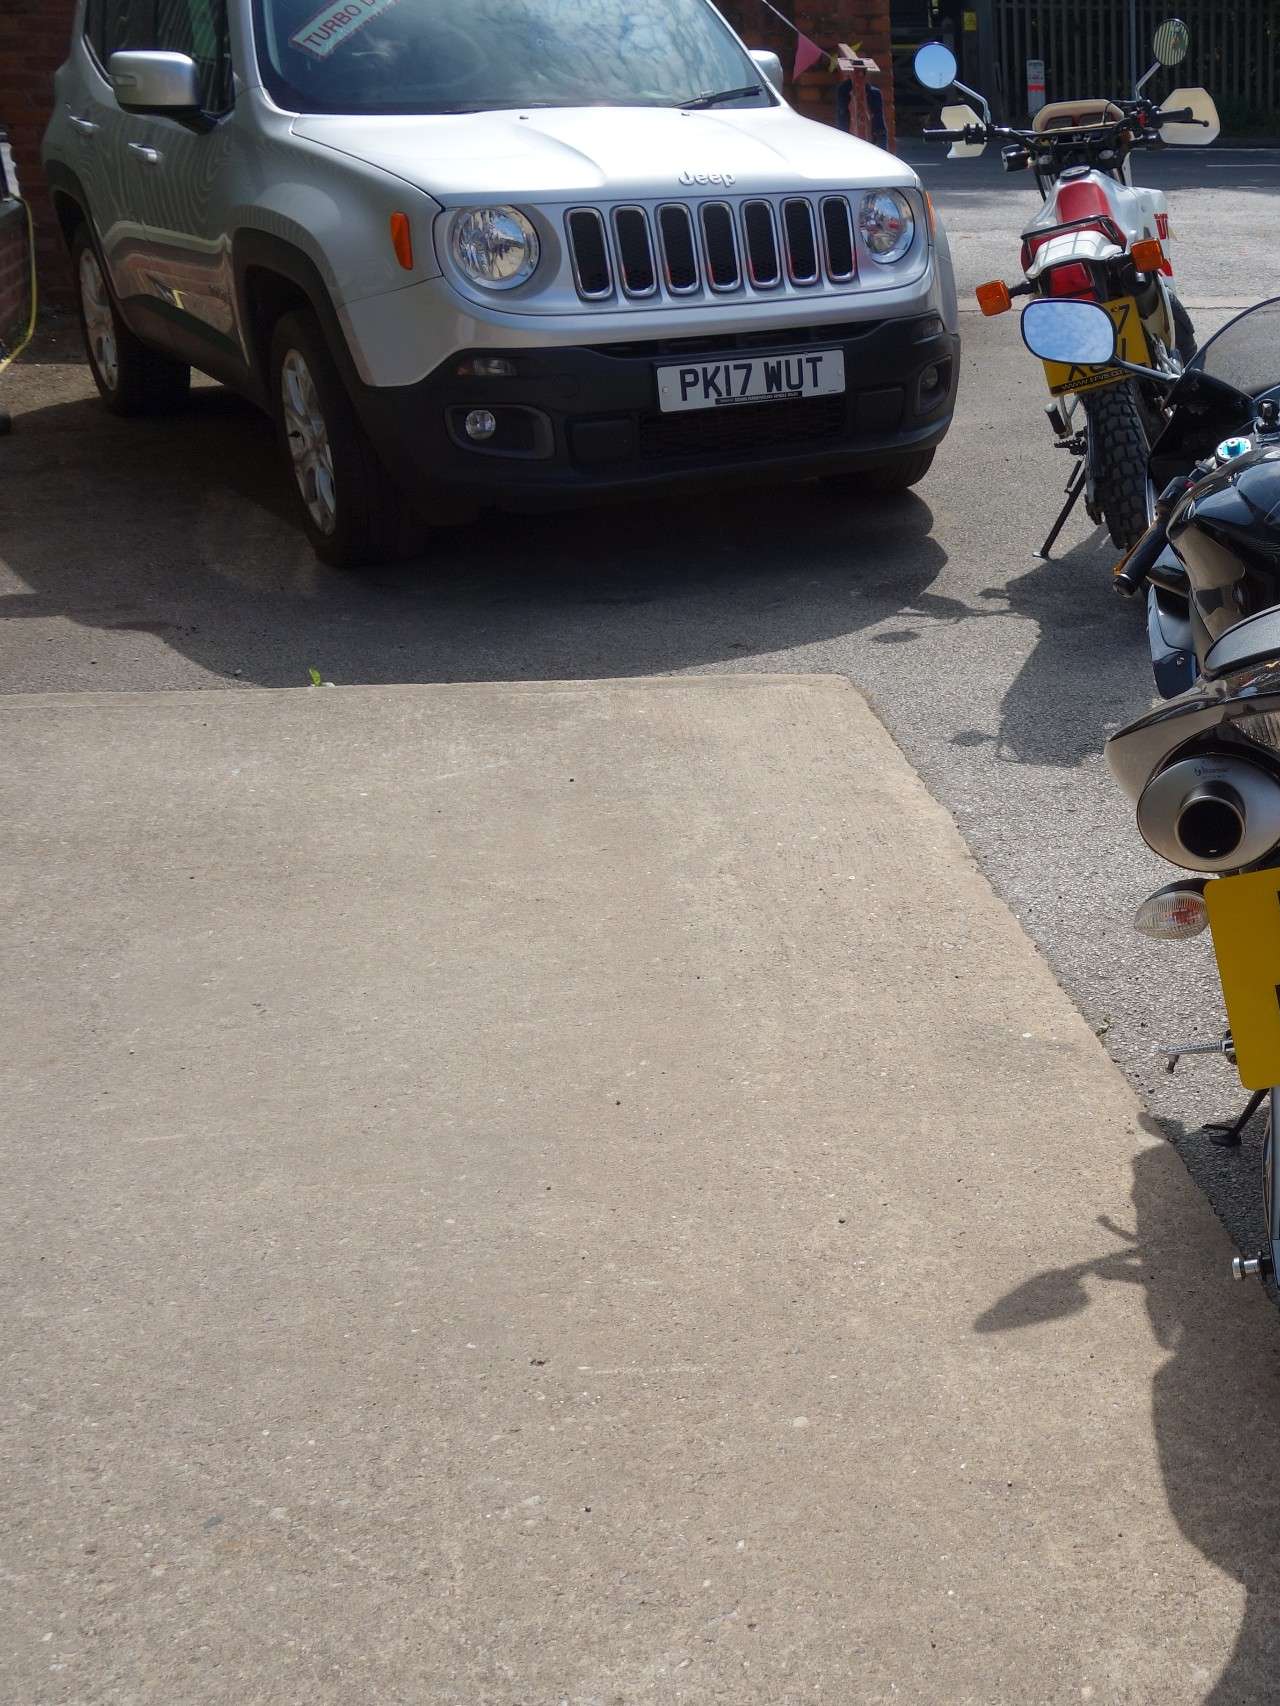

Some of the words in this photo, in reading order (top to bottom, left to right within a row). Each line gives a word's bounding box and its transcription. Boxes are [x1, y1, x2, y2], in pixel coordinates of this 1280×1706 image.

[303, 4, 362, 47] TURBO
[678, 169, 736, 189] Jeep
[679, 363, 753, 402] PK17
[763, 356, 823, 393] WUT
